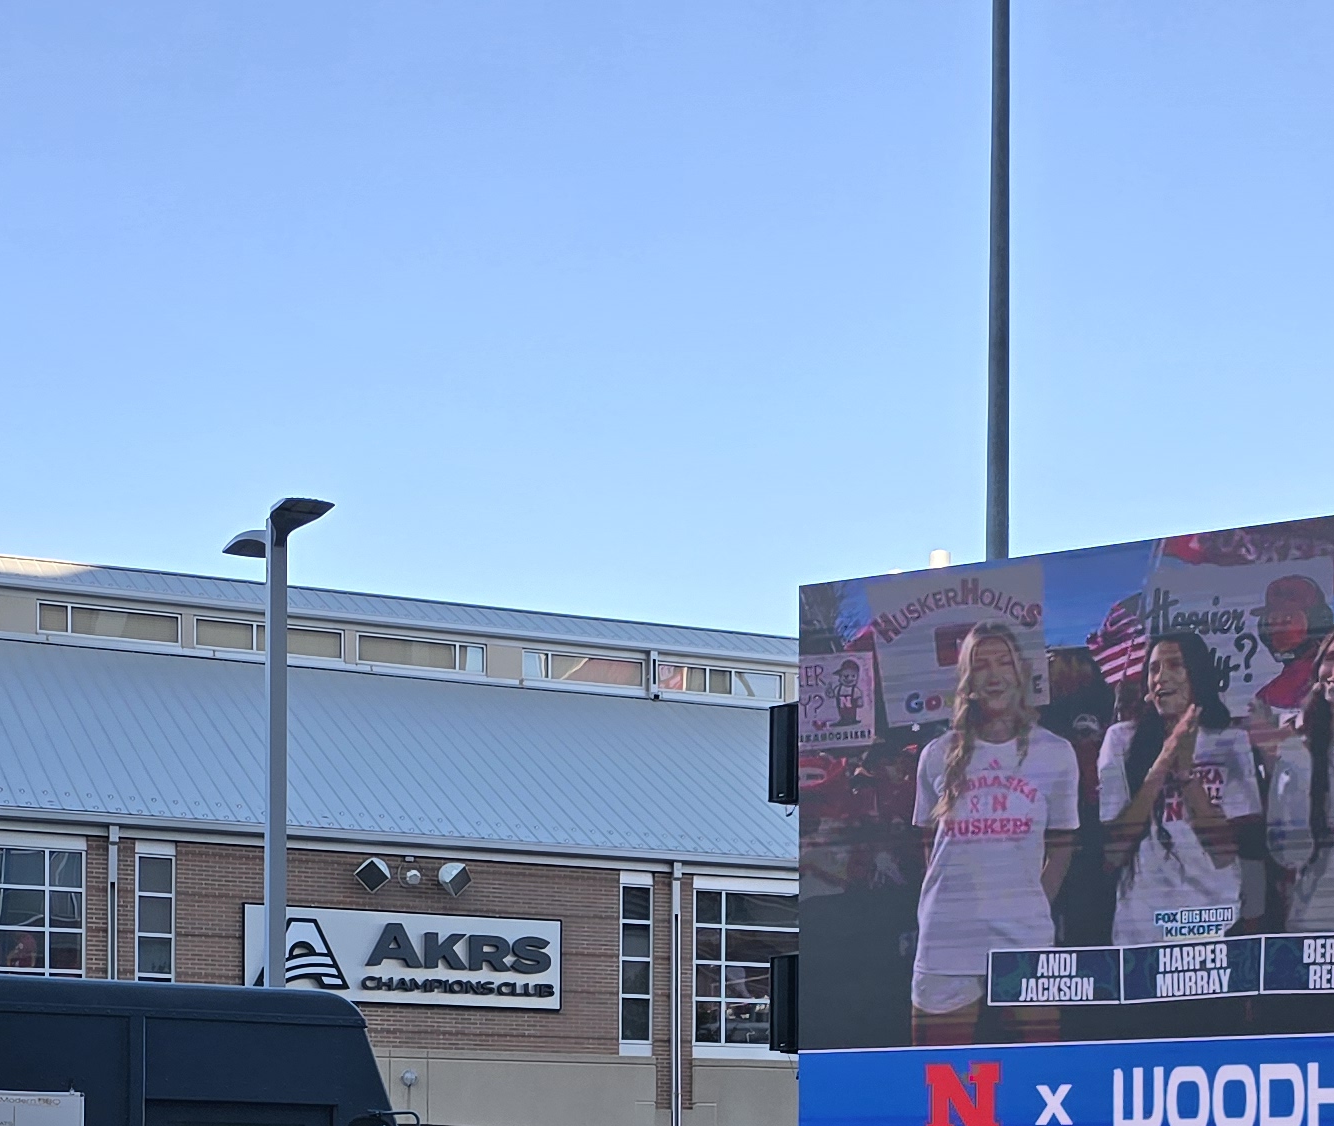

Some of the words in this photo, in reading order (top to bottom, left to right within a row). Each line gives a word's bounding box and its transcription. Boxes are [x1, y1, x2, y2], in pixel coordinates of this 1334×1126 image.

[1154, 911, 1179, 925] FOX
[1181, 909, 1200, 924] BIG
[1200, 907, 1232, 923] NOON
[1164, 923, 1223, 938] KICKOFF
[365, 922, 552, 974] AKRS
[1158, 943, 1228, 972] HARPER
[1036, 953, 1077, 977] ANDI
[361, 976, 495, 996] CHAMPIONS
[496, 981, 555, 998] CLUB
[1019, 977, 1094, 1001] JACKSON
[1156, 968, 1232, 997] MURRAY
